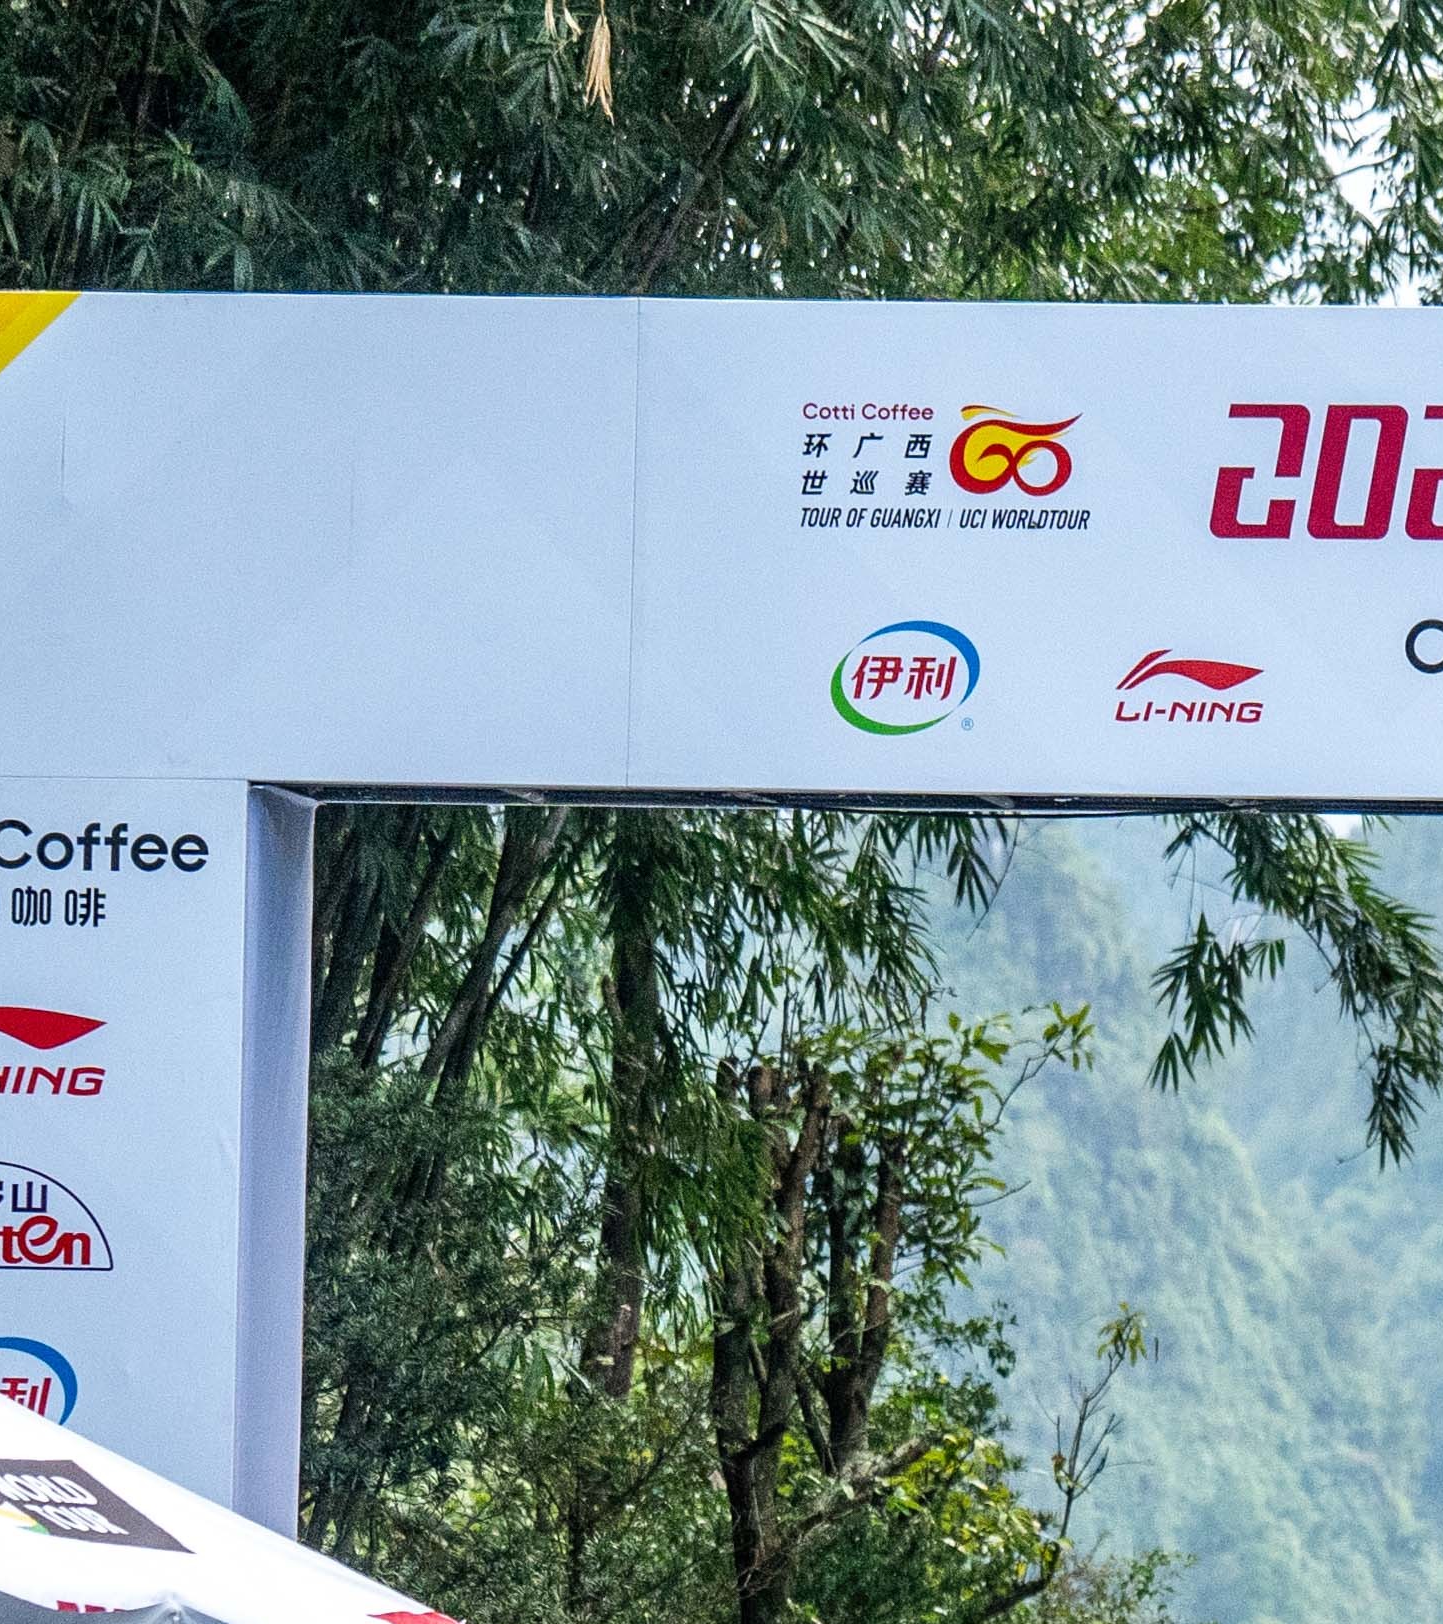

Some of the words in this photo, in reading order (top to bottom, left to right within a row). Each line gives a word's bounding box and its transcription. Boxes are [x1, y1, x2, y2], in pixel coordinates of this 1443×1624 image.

[803, 403, 854, 421] Cotti
[861, 403, 934, 421] Coffee
[800, 507, 841, 528] TOUR
[846, 508, 867, 528] OF
[870, 508, 941, 529] GUANGXI
[959, 509, 987, 529] UCI
[991, 509, 1091, 530] WORLDTOUR
[852, 655, 956, 700] 伊利
[1115, 702, 1264, 724] LI-NING
[25, 1503, 130, 1536] TOUR
